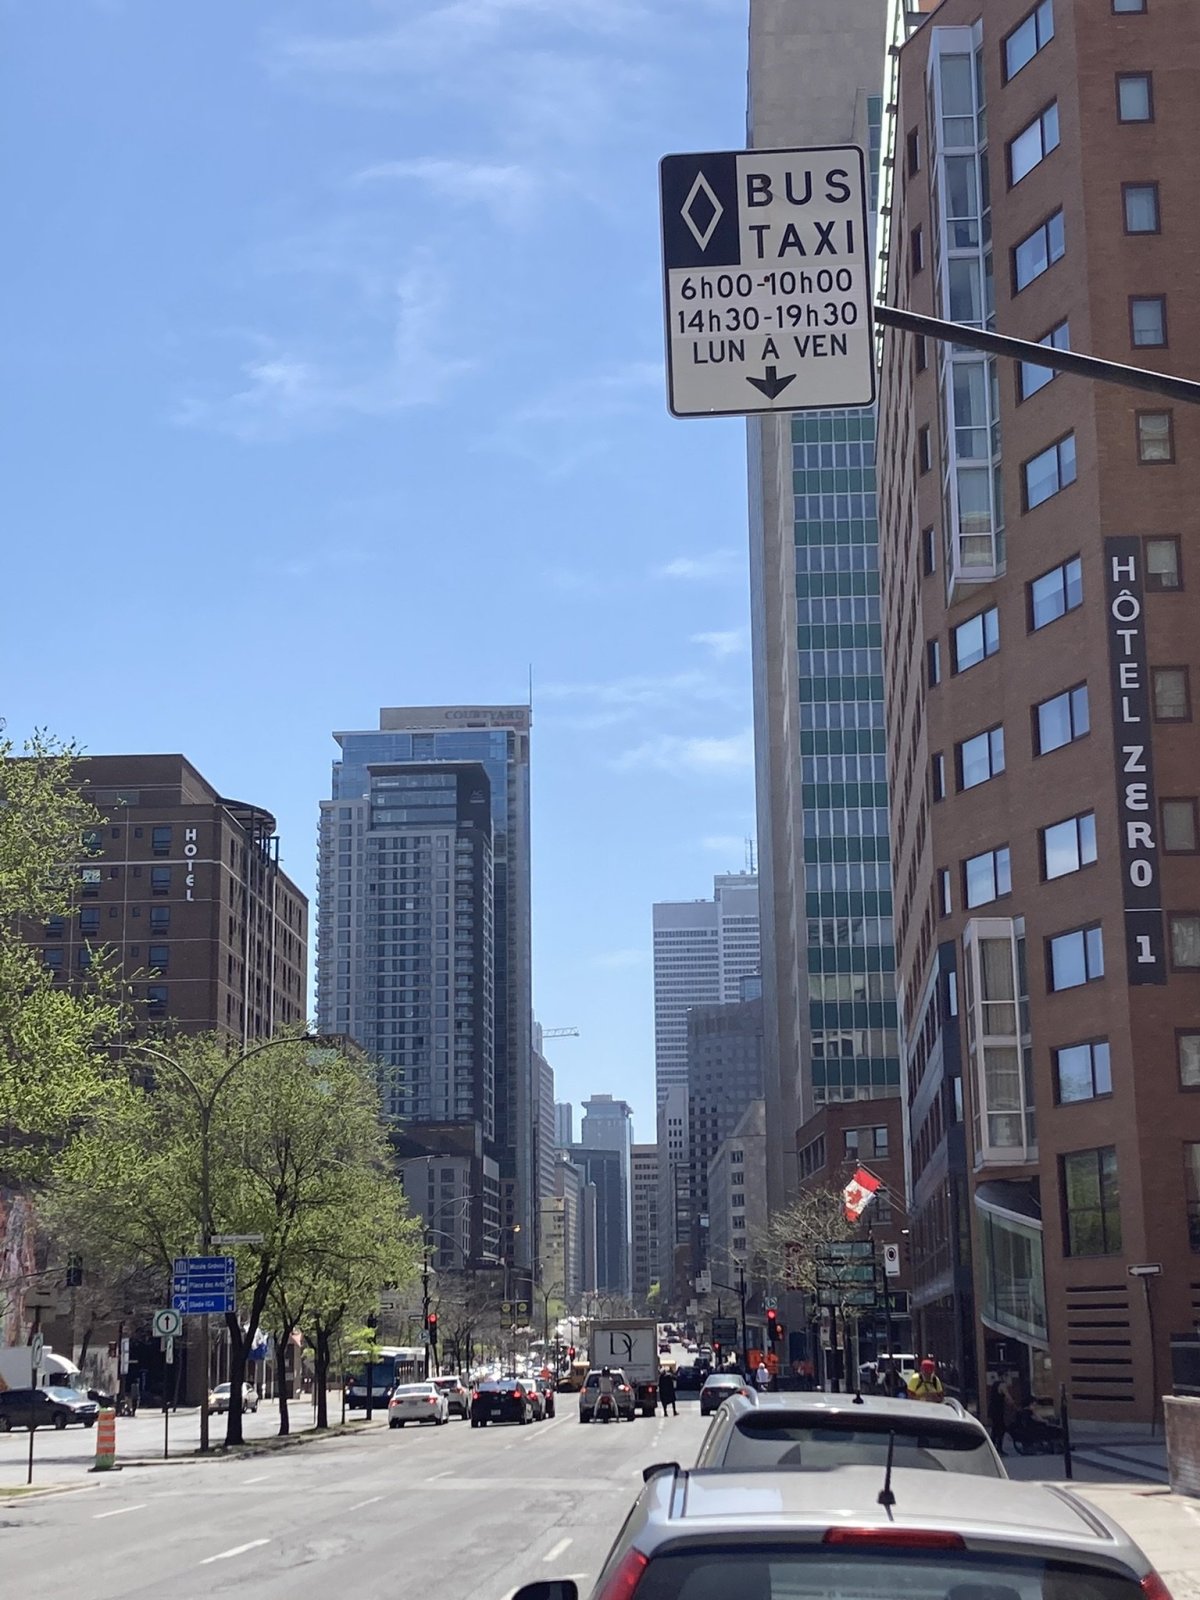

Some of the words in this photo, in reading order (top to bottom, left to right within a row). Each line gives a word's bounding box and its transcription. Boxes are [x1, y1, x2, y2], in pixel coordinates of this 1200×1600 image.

[746, 168, 850, 208] BUS
[749, 219, 854, 259] TAXI
[693, 339, 745, 364] LUN
[793, 333, 848, 358] VEN
[1111, 555, 1141, 723] HÔTEL
[444, 710, 525, 720] COURTYARD
[1121, 745, 1156, 888] ZERO
[184, 828, 198, 902] HOTEL
[1135, 935, 1157, 963] 1
